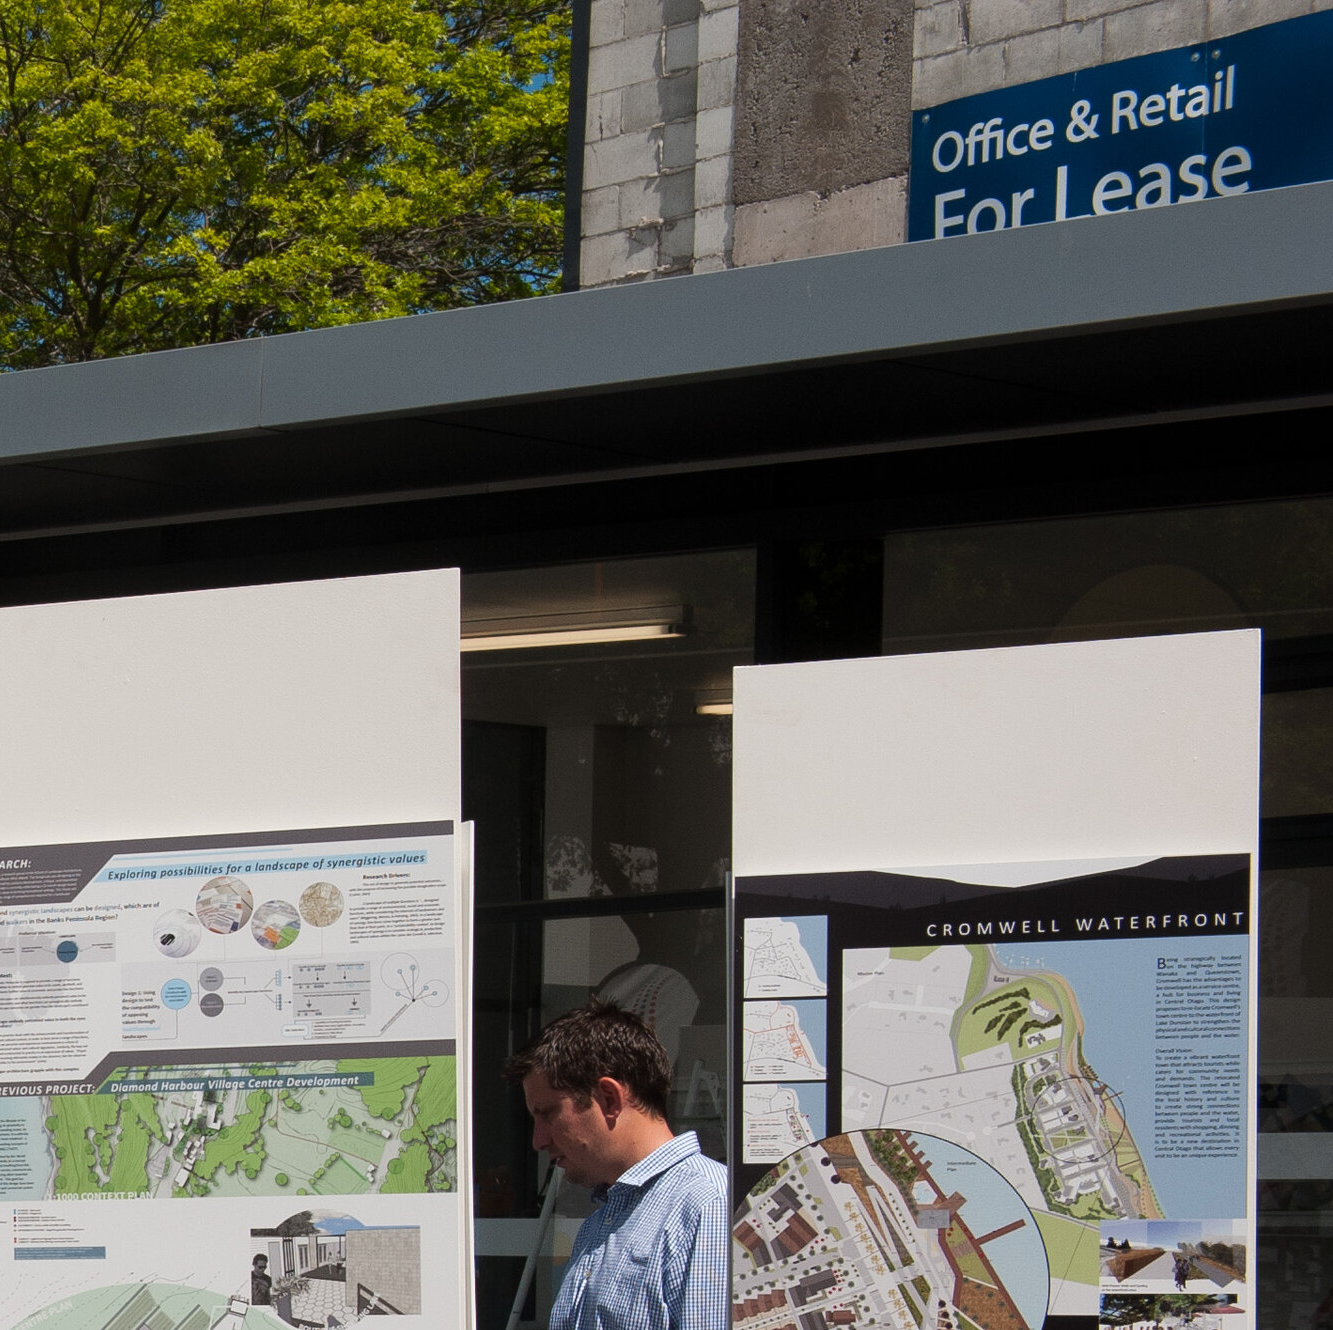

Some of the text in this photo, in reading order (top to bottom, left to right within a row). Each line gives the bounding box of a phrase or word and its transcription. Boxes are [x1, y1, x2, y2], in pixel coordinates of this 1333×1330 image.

[932, 65, 1235, 173] Office & Retail
[934, 144, 1253, 240] For Lease
[108, 868, 157, 881] Exploring
[160, 864, 223, 879] possibilities
[226, 863, 243, 875] for
[255, 860, 310, 875] landscape
[313, 858, 325, 870] of
[327, 855, 386, 869] synergistic
[389, 852, 425, 864] values
[40, 906, 73, 915] landscapes
[65, 915, 94, 923] Peninsula
[926, 912, 1245, 937] CROMWELL WATERFRONT
[46, 1083, 96, 1095] PROJECT:
[111, 1075, 359, 1093] Diamond Harbour Village Centre Development
[81, 1191, 125, 1201] CONTEXT
[128, 1191, 154, 1200] PLAN
